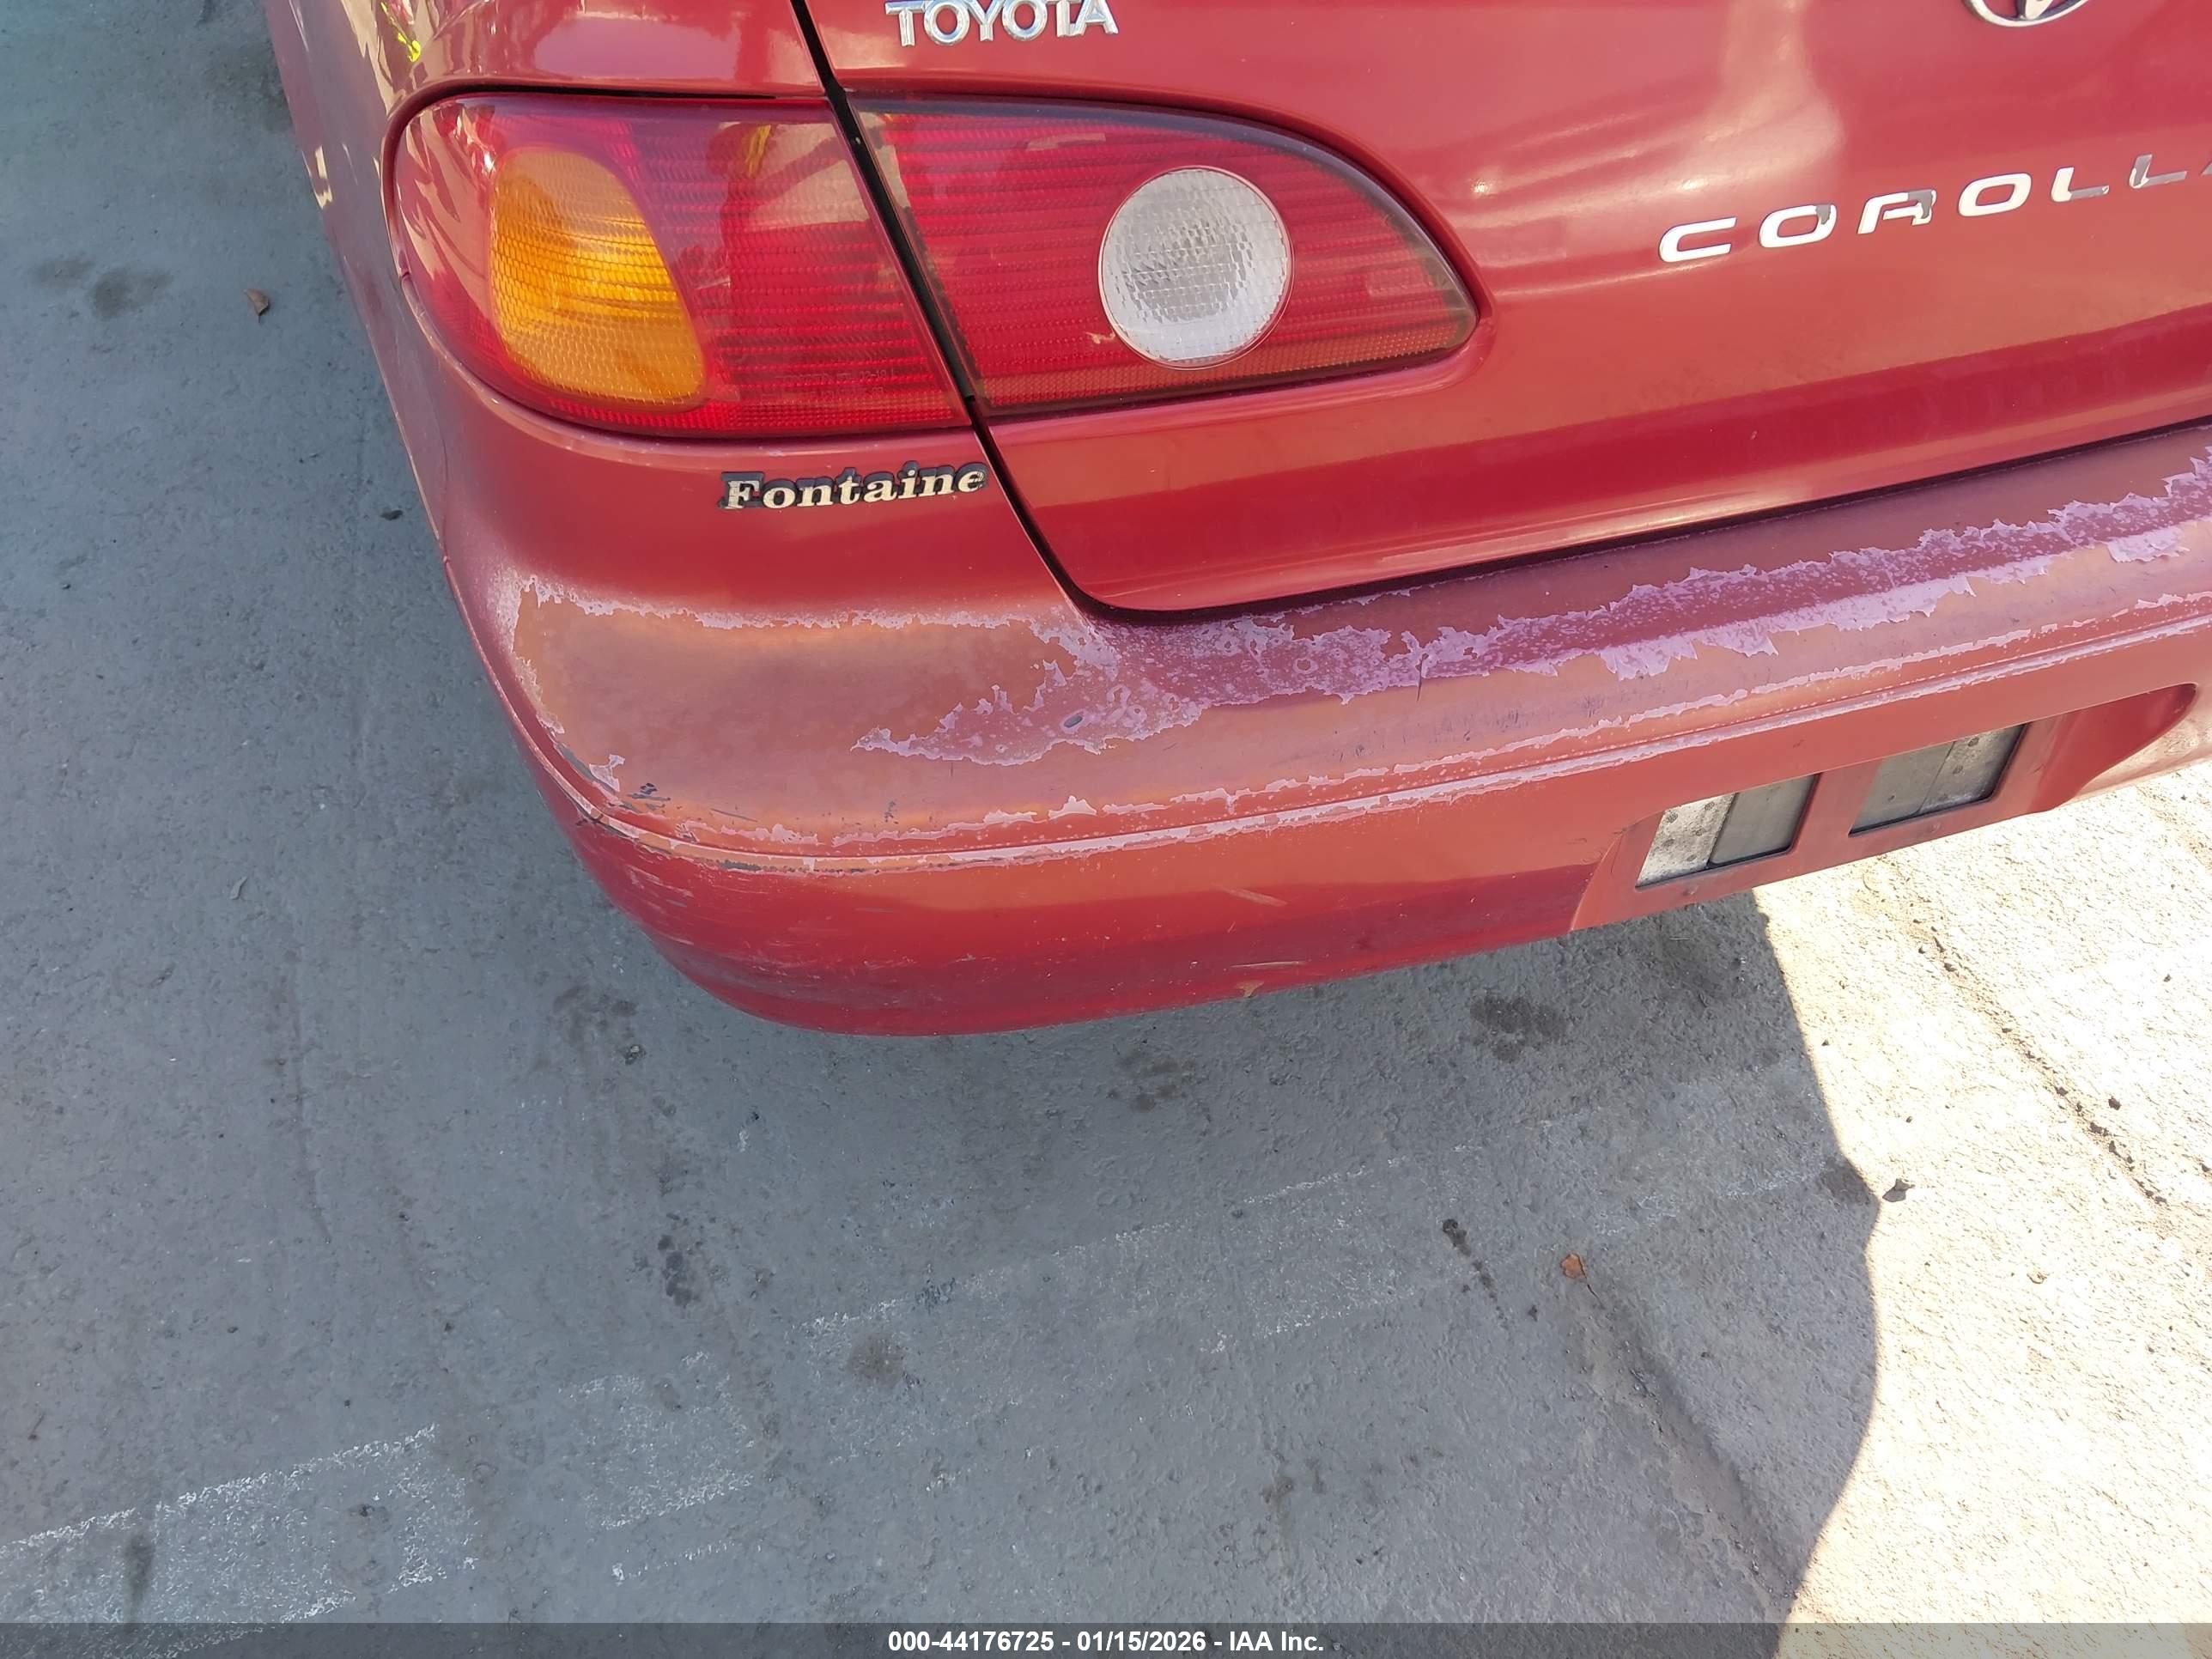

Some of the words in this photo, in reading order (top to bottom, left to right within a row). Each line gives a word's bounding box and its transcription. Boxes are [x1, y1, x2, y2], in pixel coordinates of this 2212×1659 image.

[885, 0, 1119, 47] TOYOTA
[1658, 153, 2212, 264] COROLL
[720, 461, 988, 510] Fontaine
